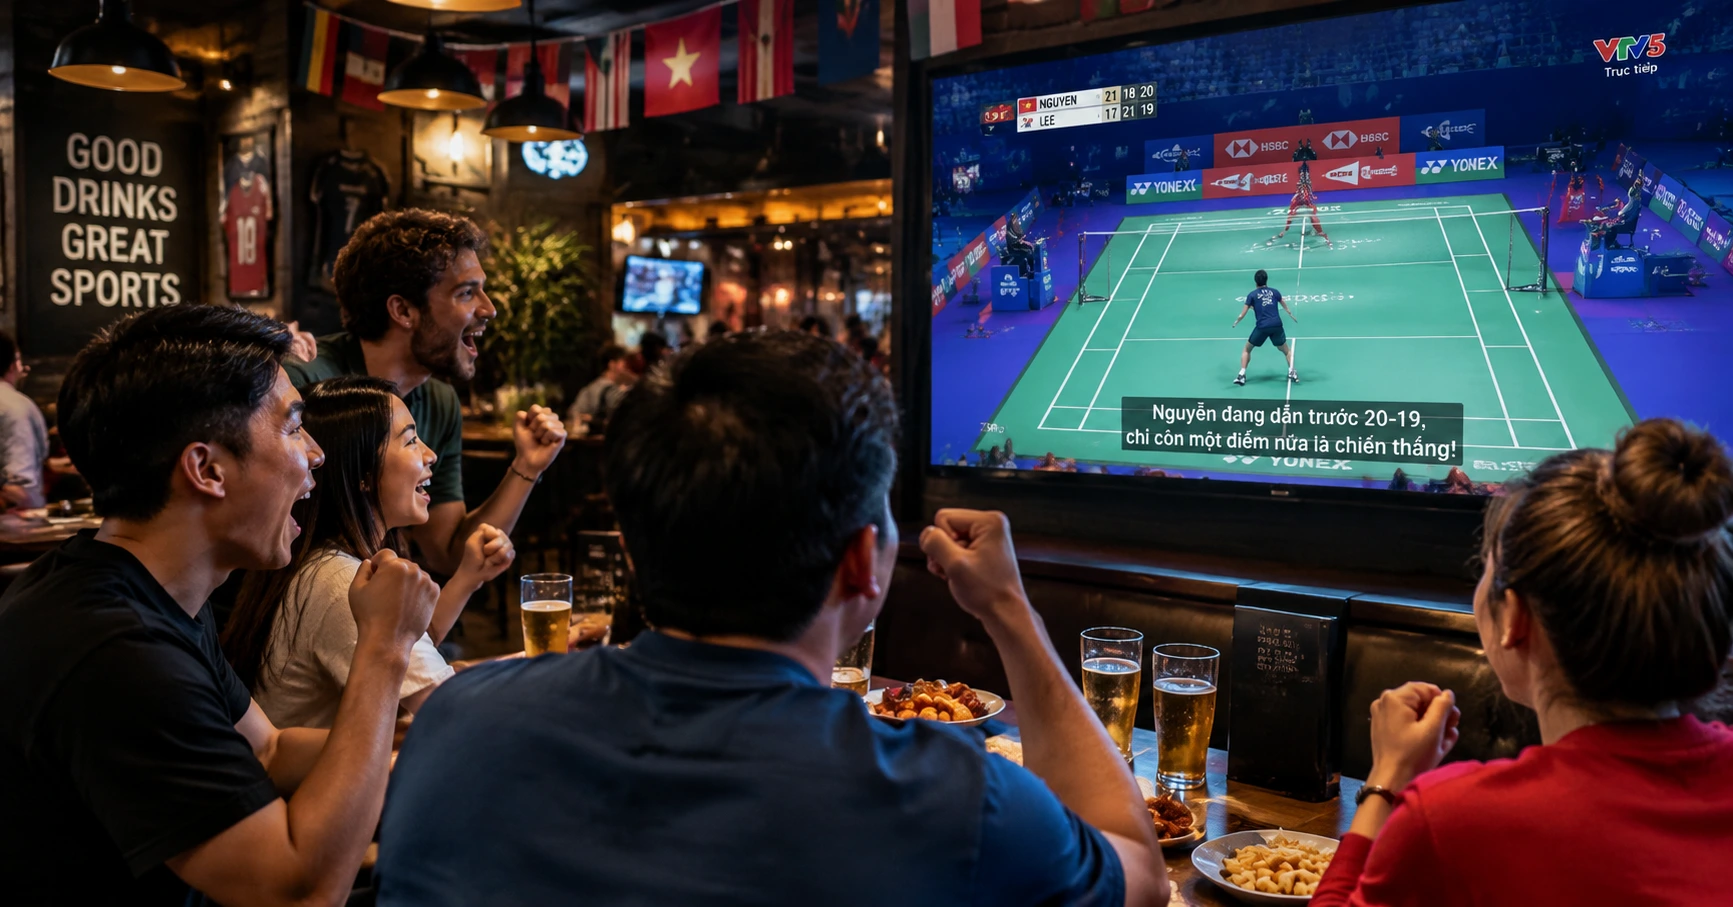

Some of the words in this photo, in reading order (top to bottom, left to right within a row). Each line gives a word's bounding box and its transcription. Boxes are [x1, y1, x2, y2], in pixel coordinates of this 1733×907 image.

[1593, 33, 1666, 62] VTV5
[1039, 95, 1077, 109] NGUYEN
[1105, 90, 1117, 102] 21
[1123, 87, 1136, 99] 18
[1140, 85, 1154, 98] 20
[1039, 115, 1055, 127] LEE
[1105, 108, 1117, 120] 17
[1123, 105, 1135, 118] 21
[1141, 103, 1154, 115] 19
[67, 132, 162, 177] GOOD
[1450, 156, 1499, 172] YONEX
[53, 176, 178, 222] DRINKS
[62, 223, 169, 265] GREAT
[51, 268, 181, 308] SPORTS
[1153, 402, 1216, 425] Nguyễn
[1222, 405, 1265, 427] đang
[1308, 408, 1359, 425] trước
[1364, 409, 1426, 431] 20-19,
